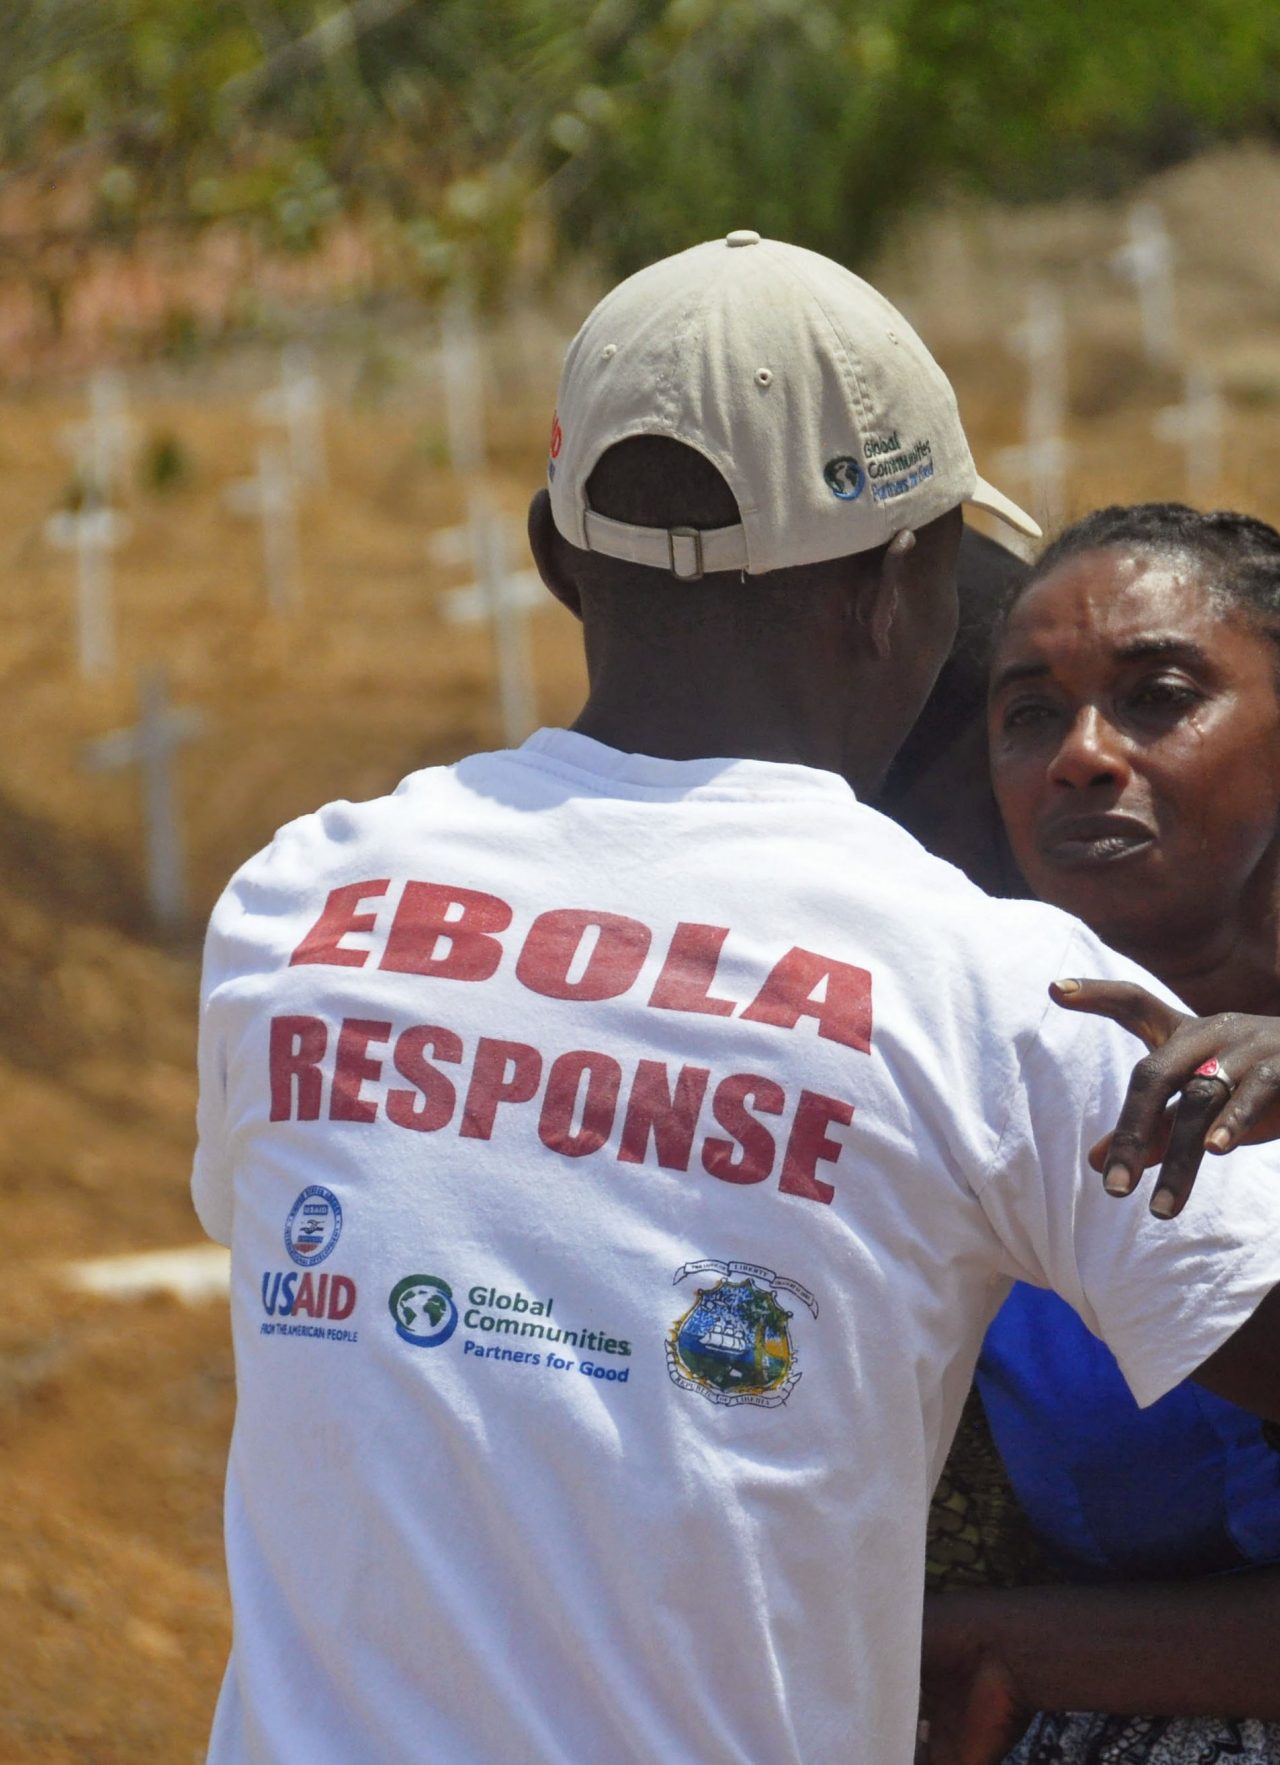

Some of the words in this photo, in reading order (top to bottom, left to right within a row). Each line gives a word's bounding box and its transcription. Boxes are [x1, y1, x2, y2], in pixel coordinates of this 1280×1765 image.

[864, 431, 901, 458] Global
[289, 878, 873, 1055] EBOLA
[268, 1014, 855, 1205] RESPONSE
[262, 1271, 357, 1320] USAID
[468, 1286, 553, 1318] Global
[287, 1324, 325, 1339] AMERICAN
[326, 1328, 358, 1342] PEOPLE
[464, 1309, 632, 1356] Communities
[463, 1340, 541, 1365] Partners
[546, 1353, 574, 1370] for
[579, 1361, 629, 1382] Good
